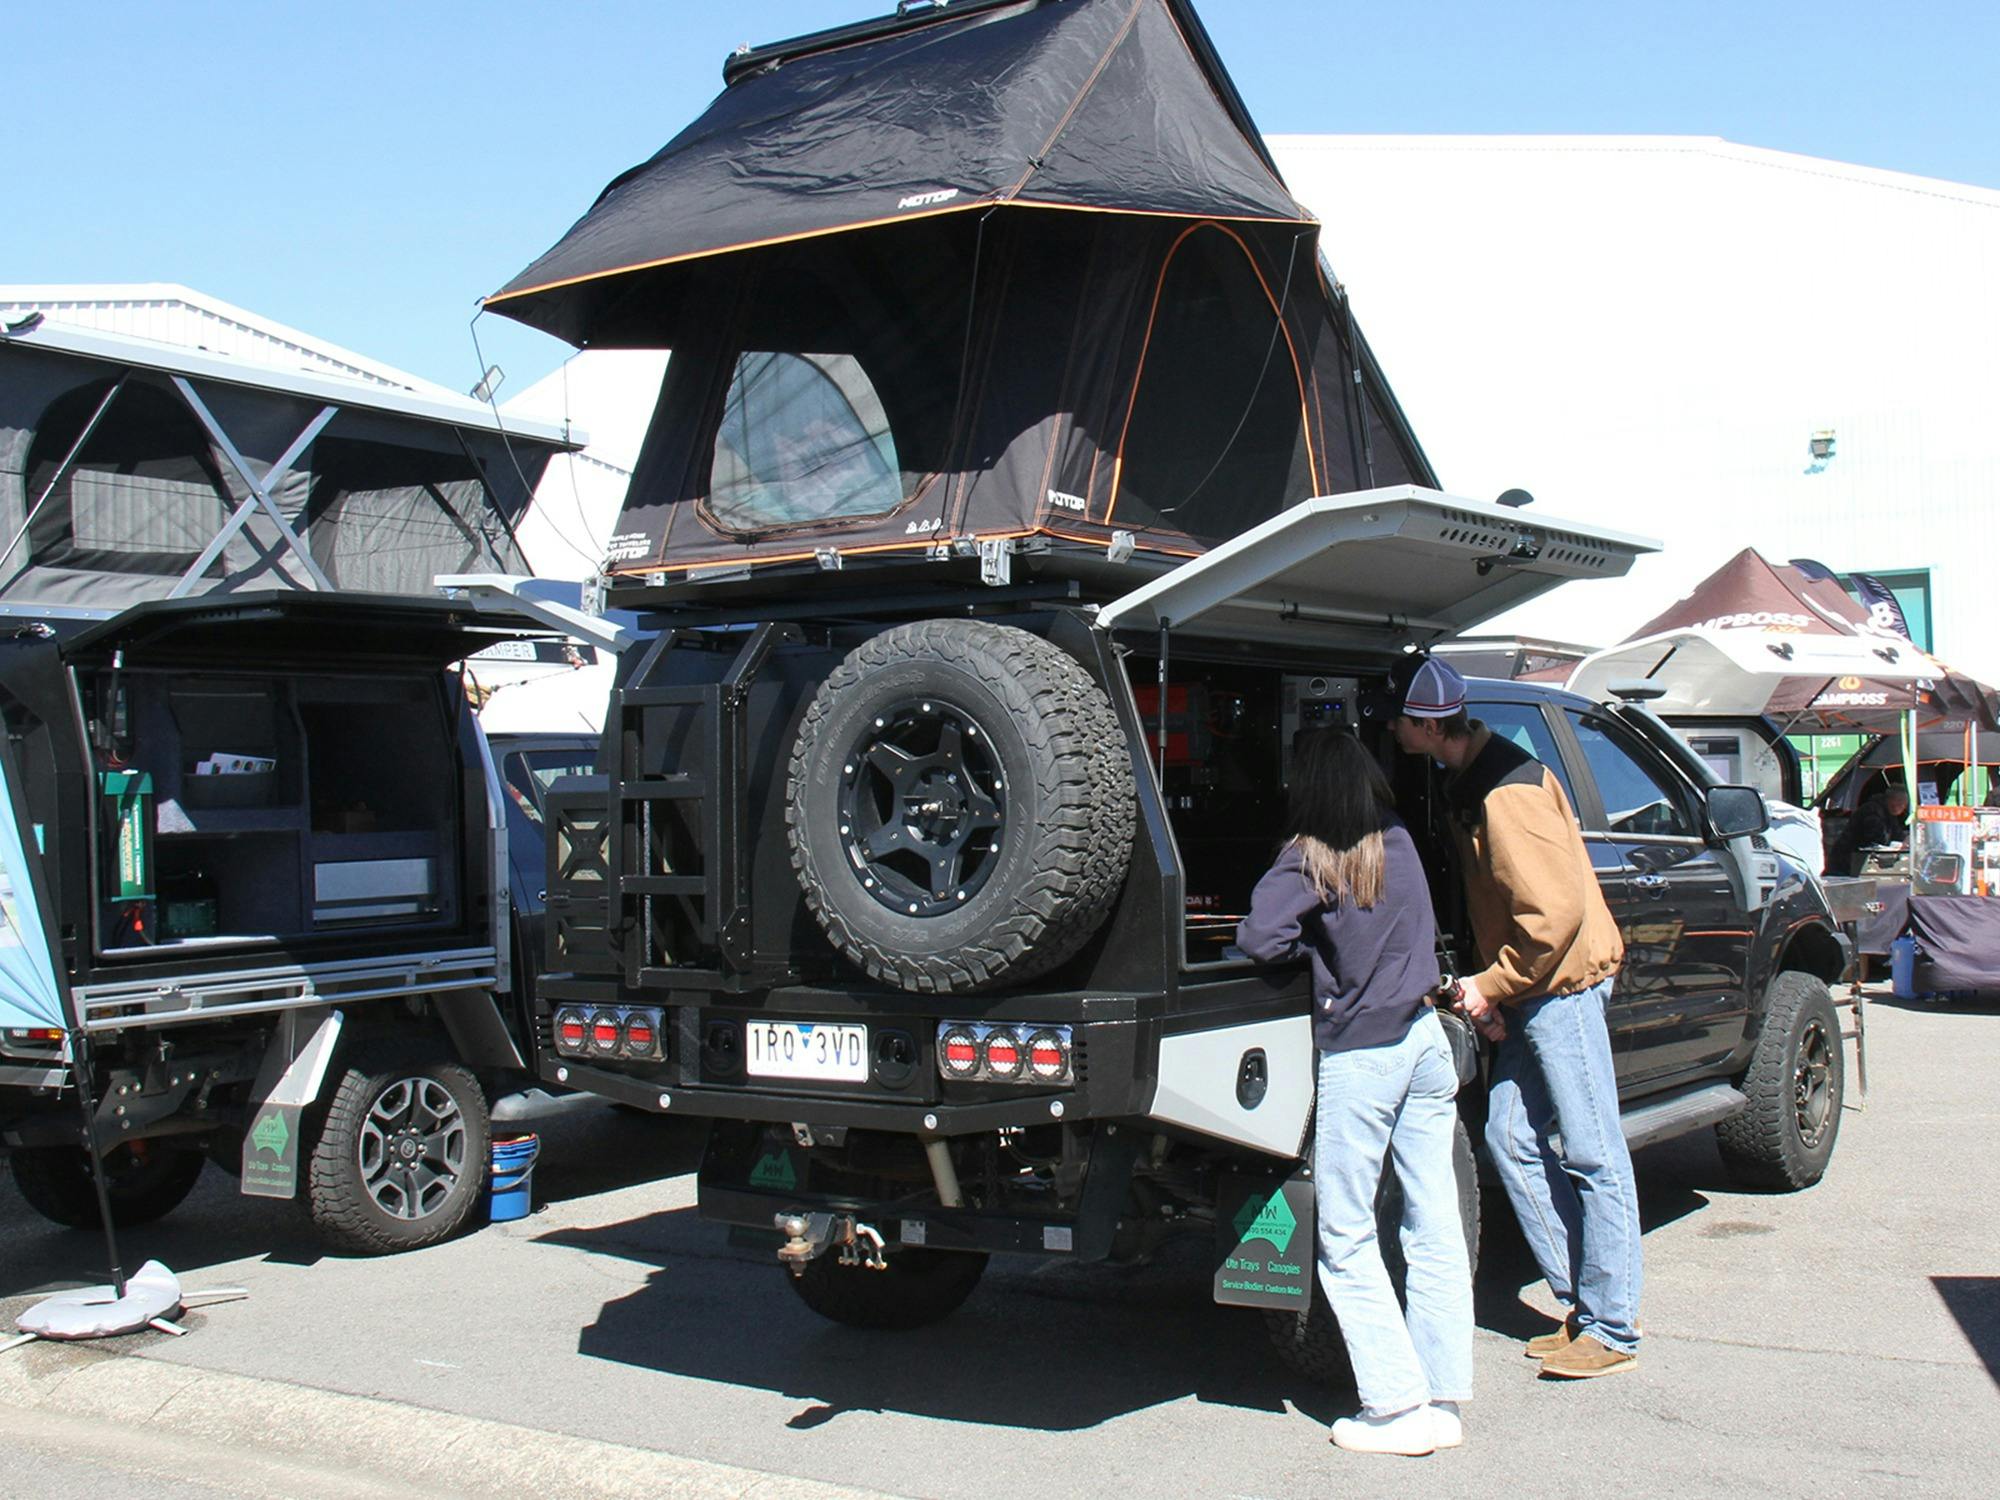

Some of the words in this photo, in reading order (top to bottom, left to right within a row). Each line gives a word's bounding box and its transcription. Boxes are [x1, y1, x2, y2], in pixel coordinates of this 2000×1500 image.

[1690, 612, 1810, 634] MPBOSS
[1225, 1258, 1239, 1269] Ute
[1240, 1258, 1260, 1272] Trays
[1267, 1261, 1301, 1275] Canopies
[1222, 1280, 1243, 1290] Service
